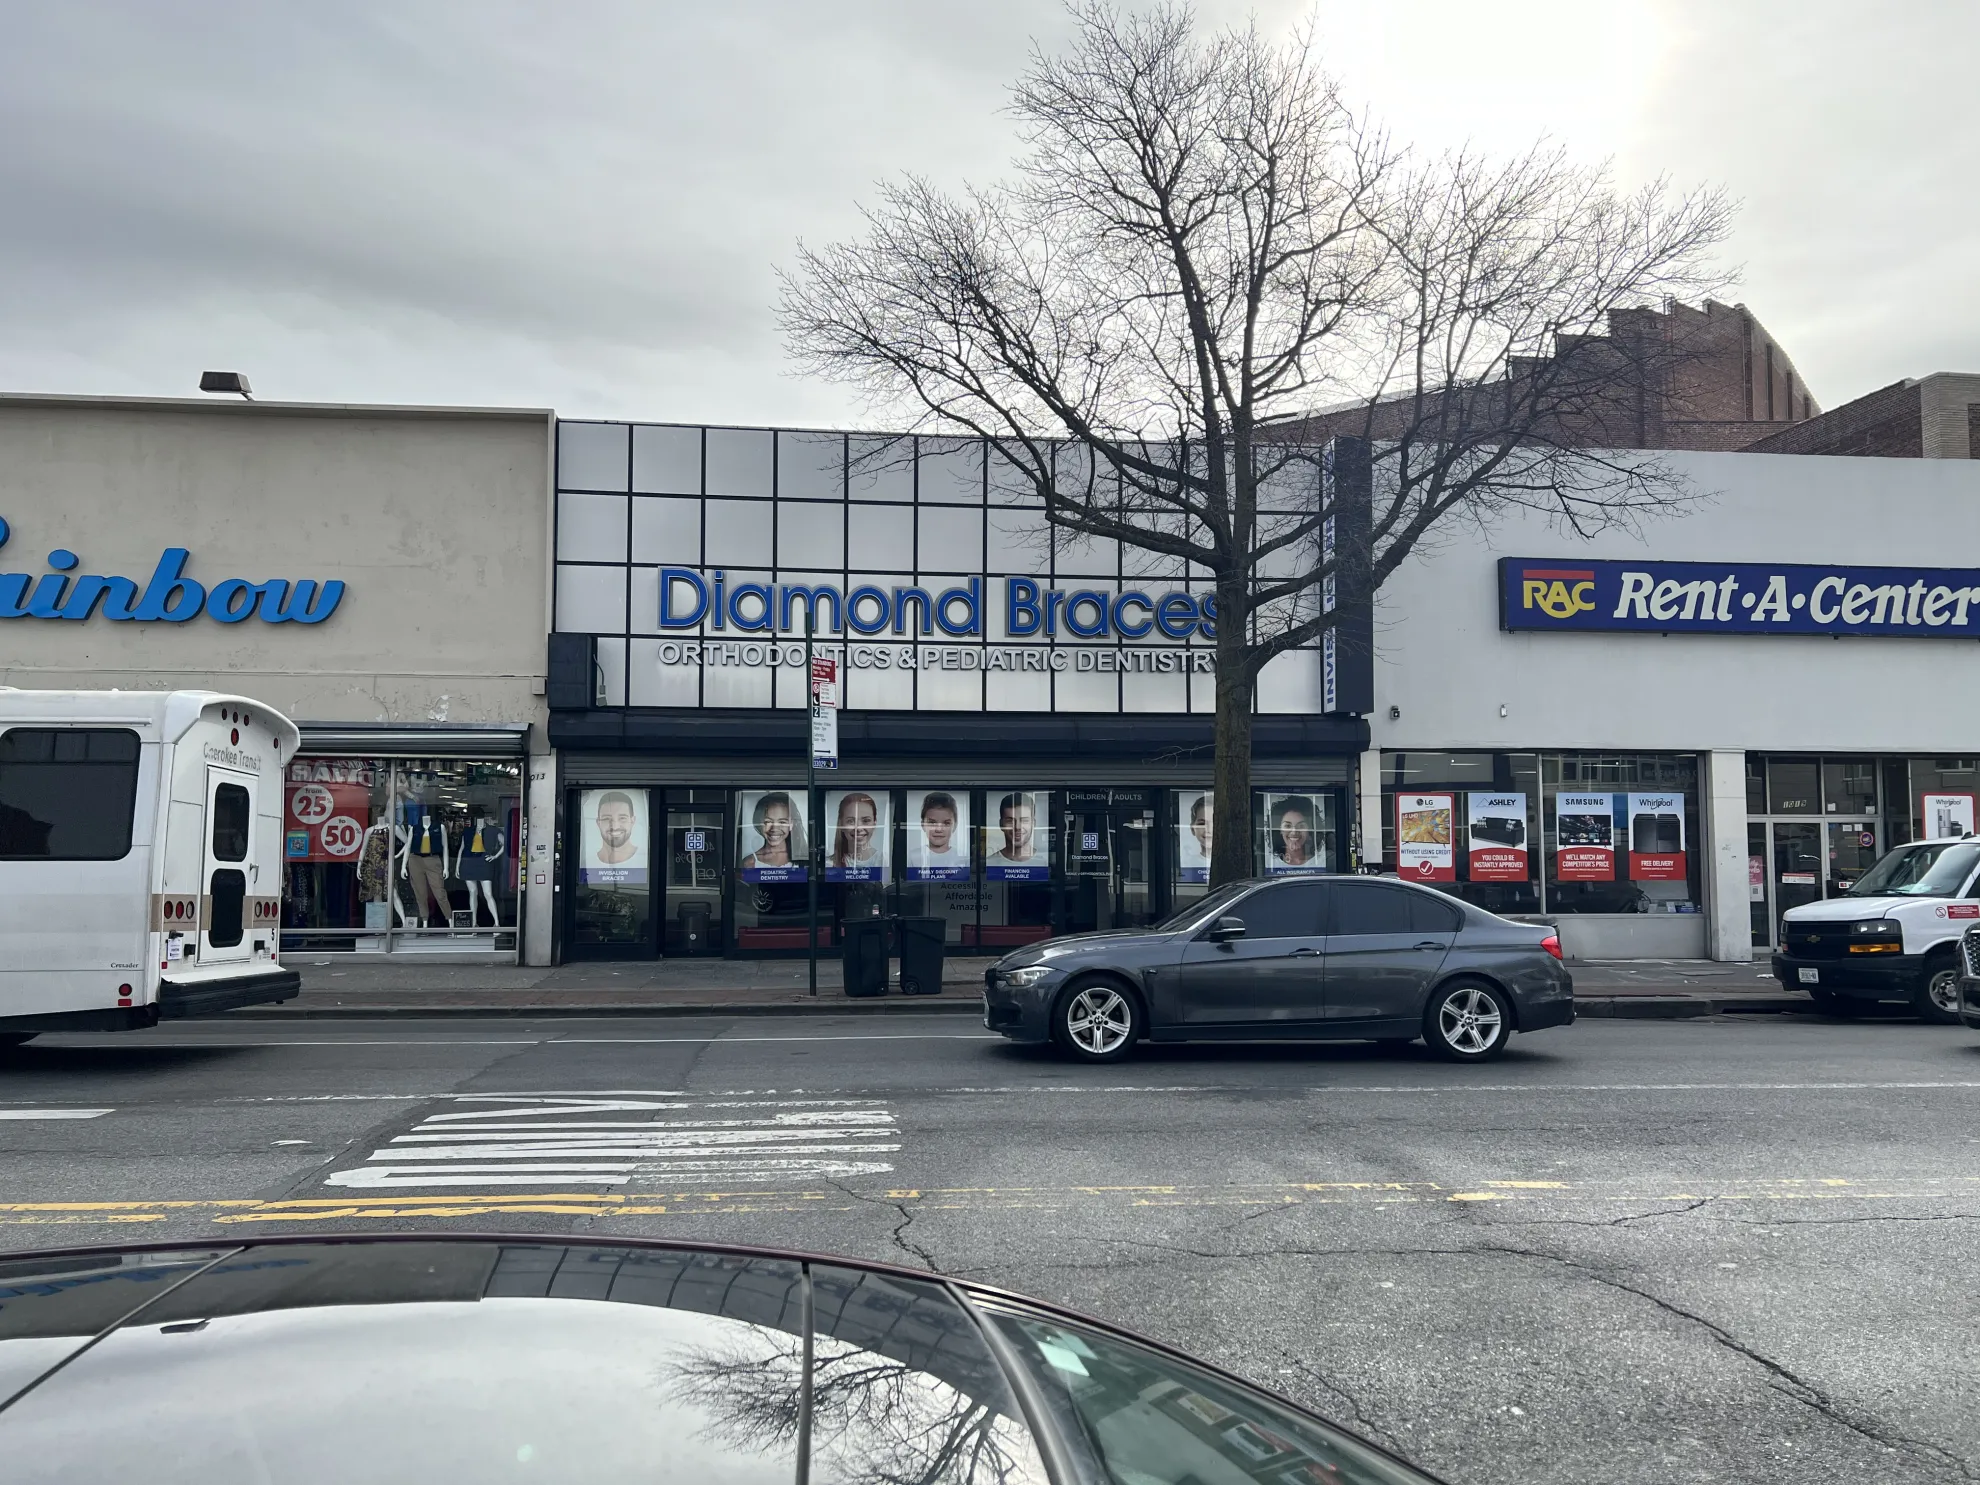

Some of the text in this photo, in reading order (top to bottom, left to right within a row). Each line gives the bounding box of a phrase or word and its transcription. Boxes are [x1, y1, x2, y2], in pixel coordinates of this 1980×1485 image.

[0, 516, 345, 623] inbow
[658, 566, 1217, 640] Diamond Braces
[1523, 580, 1596, 619] RAC
[897, 646, 918, 669] &
[922, 648, 1068, 672] PEDIATRIC
[1076, 651, 1217, 674] DENTISTR
[1070, 793, 1106, 801] CHILDREN
[1114, 793, 1142, 801] ADULTS
[1565, 798, 1604, 806] SAMSUNG
[1639, 798, 1674, 809] Whirlpool
[1936, 798, 1962, 807] Whirlpool
[941, 881, 988, 890] Accessie
[110, 961, 140, 969] Crusader
